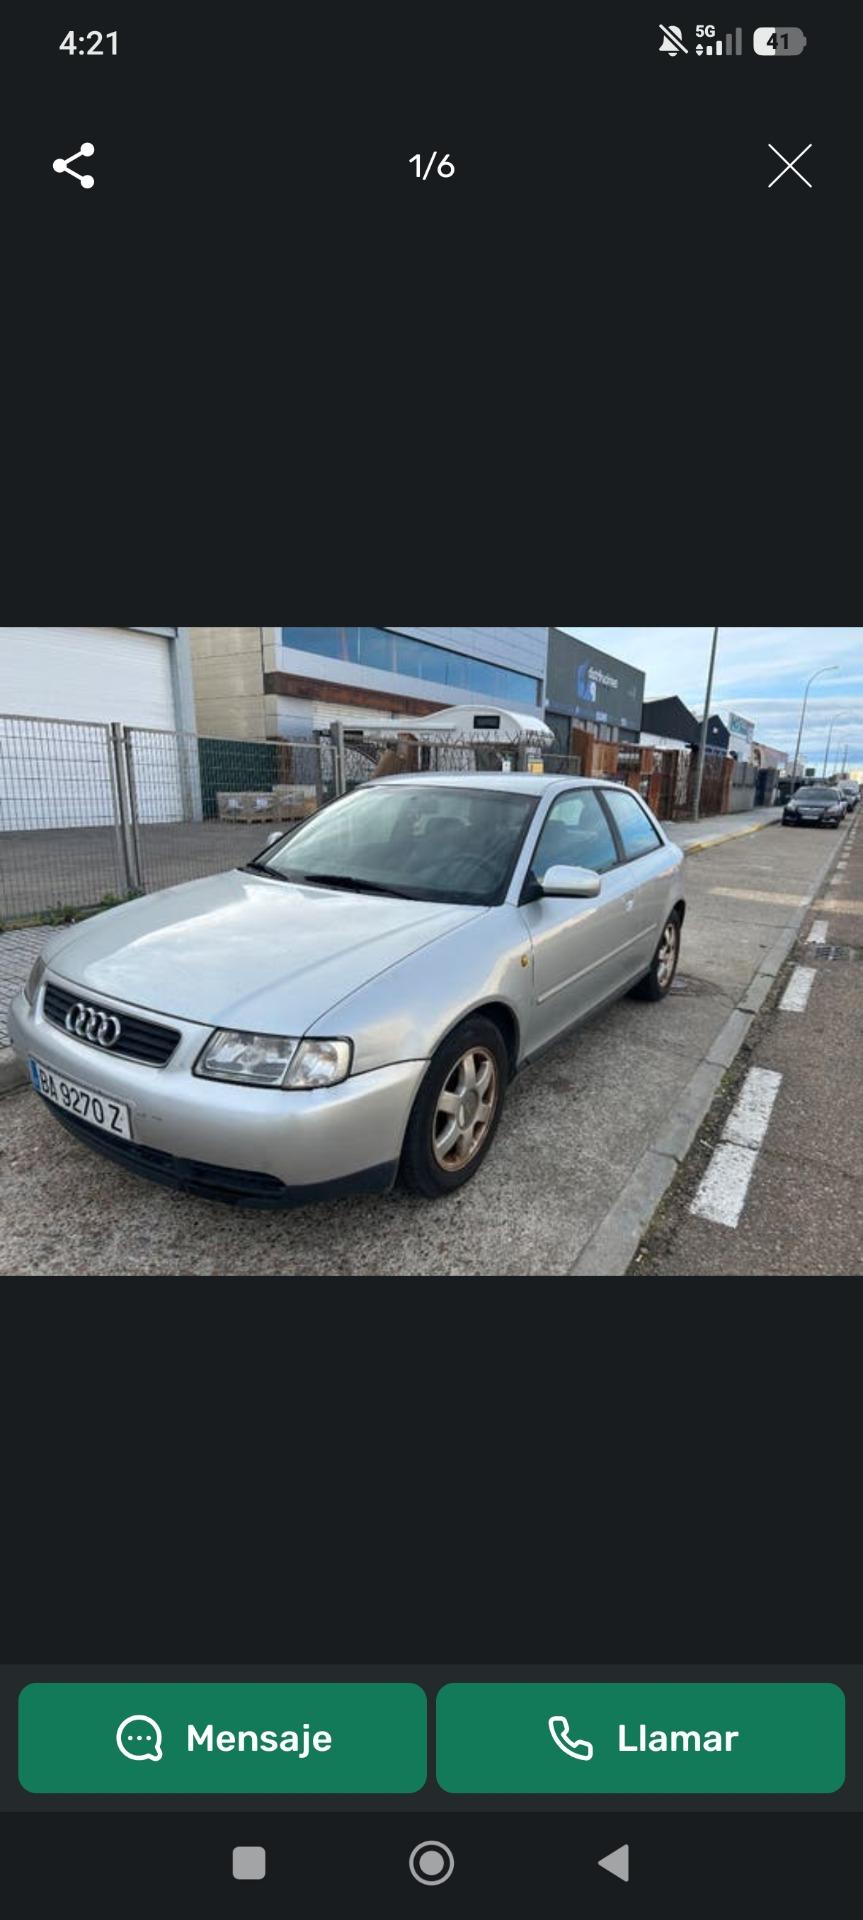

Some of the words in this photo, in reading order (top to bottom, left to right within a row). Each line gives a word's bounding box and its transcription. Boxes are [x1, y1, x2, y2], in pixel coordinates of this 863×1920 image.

[59, 31, 118, 55] 4:21
[695, 24, 716, 38] 5G
[767, 33, 789, 49] 41
[408, 151, 456, 180] 1/6
[39, 1069, 58, 1100] BA
[60, 1083, 104, 1124] 9270
[108, 1104, 123, 1133] Z
[187, 1723, 332, 1759] Mensaje
[618, 1724, 739, 1752] Llamar
